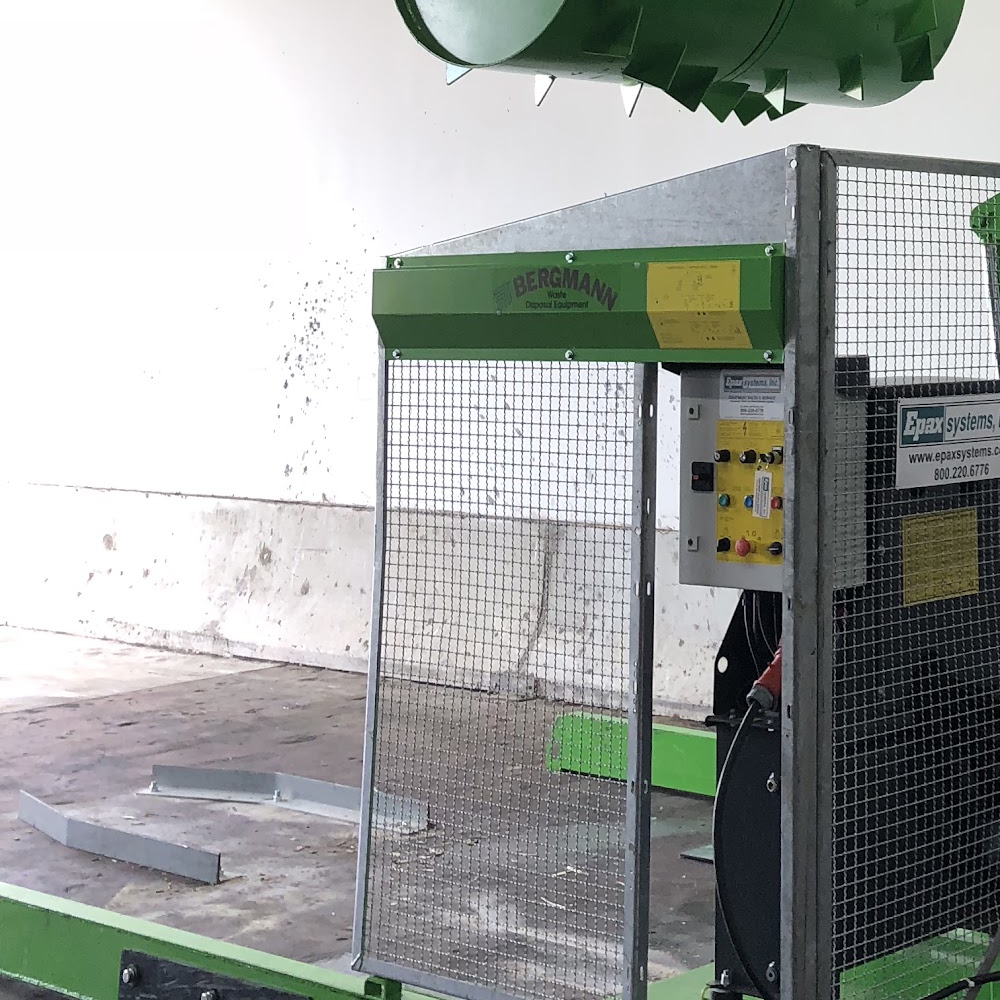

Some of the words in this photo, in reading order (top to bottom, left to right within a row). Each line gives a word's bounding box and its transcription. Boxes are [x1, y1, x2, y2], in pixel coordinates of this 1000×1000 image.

[513, 266, 619, 311] BERGMANN
[547, 291, 567, 299] Waste
[525, 300, 552, 309] Disposal
[554, 300, 589, 309] Equipment
[903, 410, 943, 442] Epax
[946, 412, 996, 437] systems,
[934, 463, 990, 481] 800.220.6776
